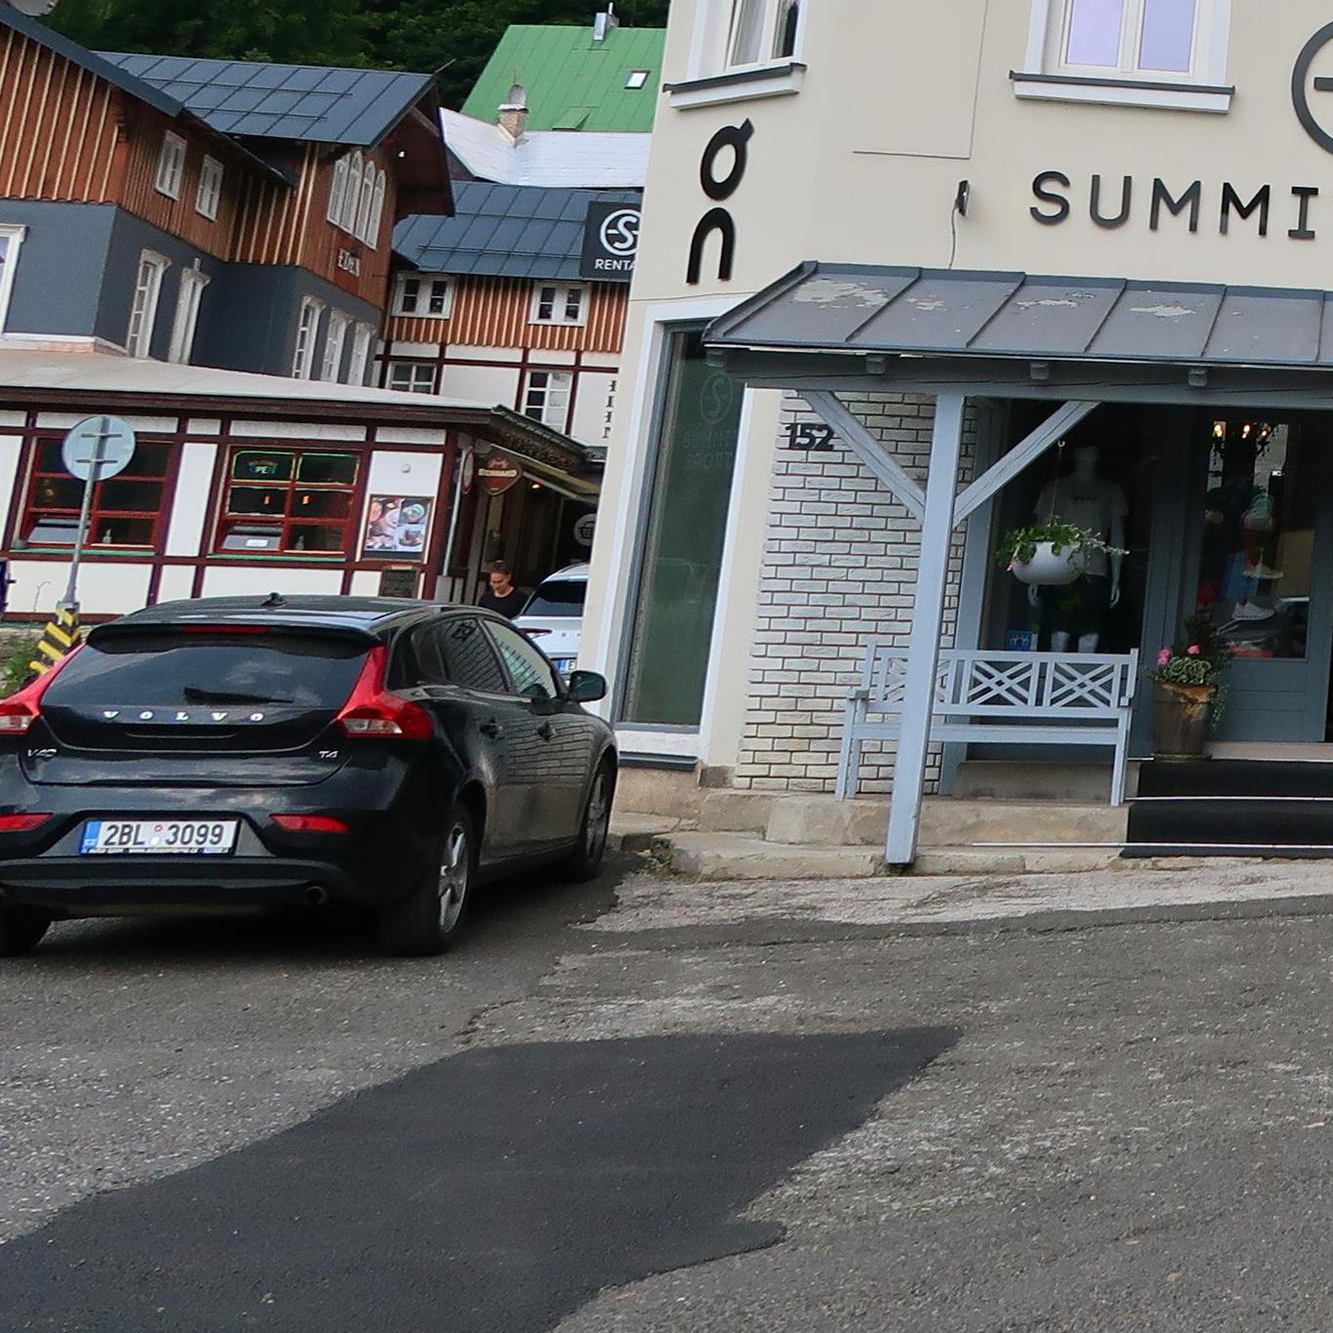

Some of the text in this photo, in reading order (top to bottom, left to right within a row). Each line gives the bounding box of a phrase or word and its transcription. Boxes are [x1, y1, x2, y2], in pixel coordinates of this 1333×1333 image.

[595, 259, 637, 270] RENTA
[786, 423, 834, 450] 152
[103, 710, 264, 723] VOLVO
[27, 748, 57, 758] V40
[318, 749, 339, 759] T4
[103, 823, 223, 846] 2BL 3099
